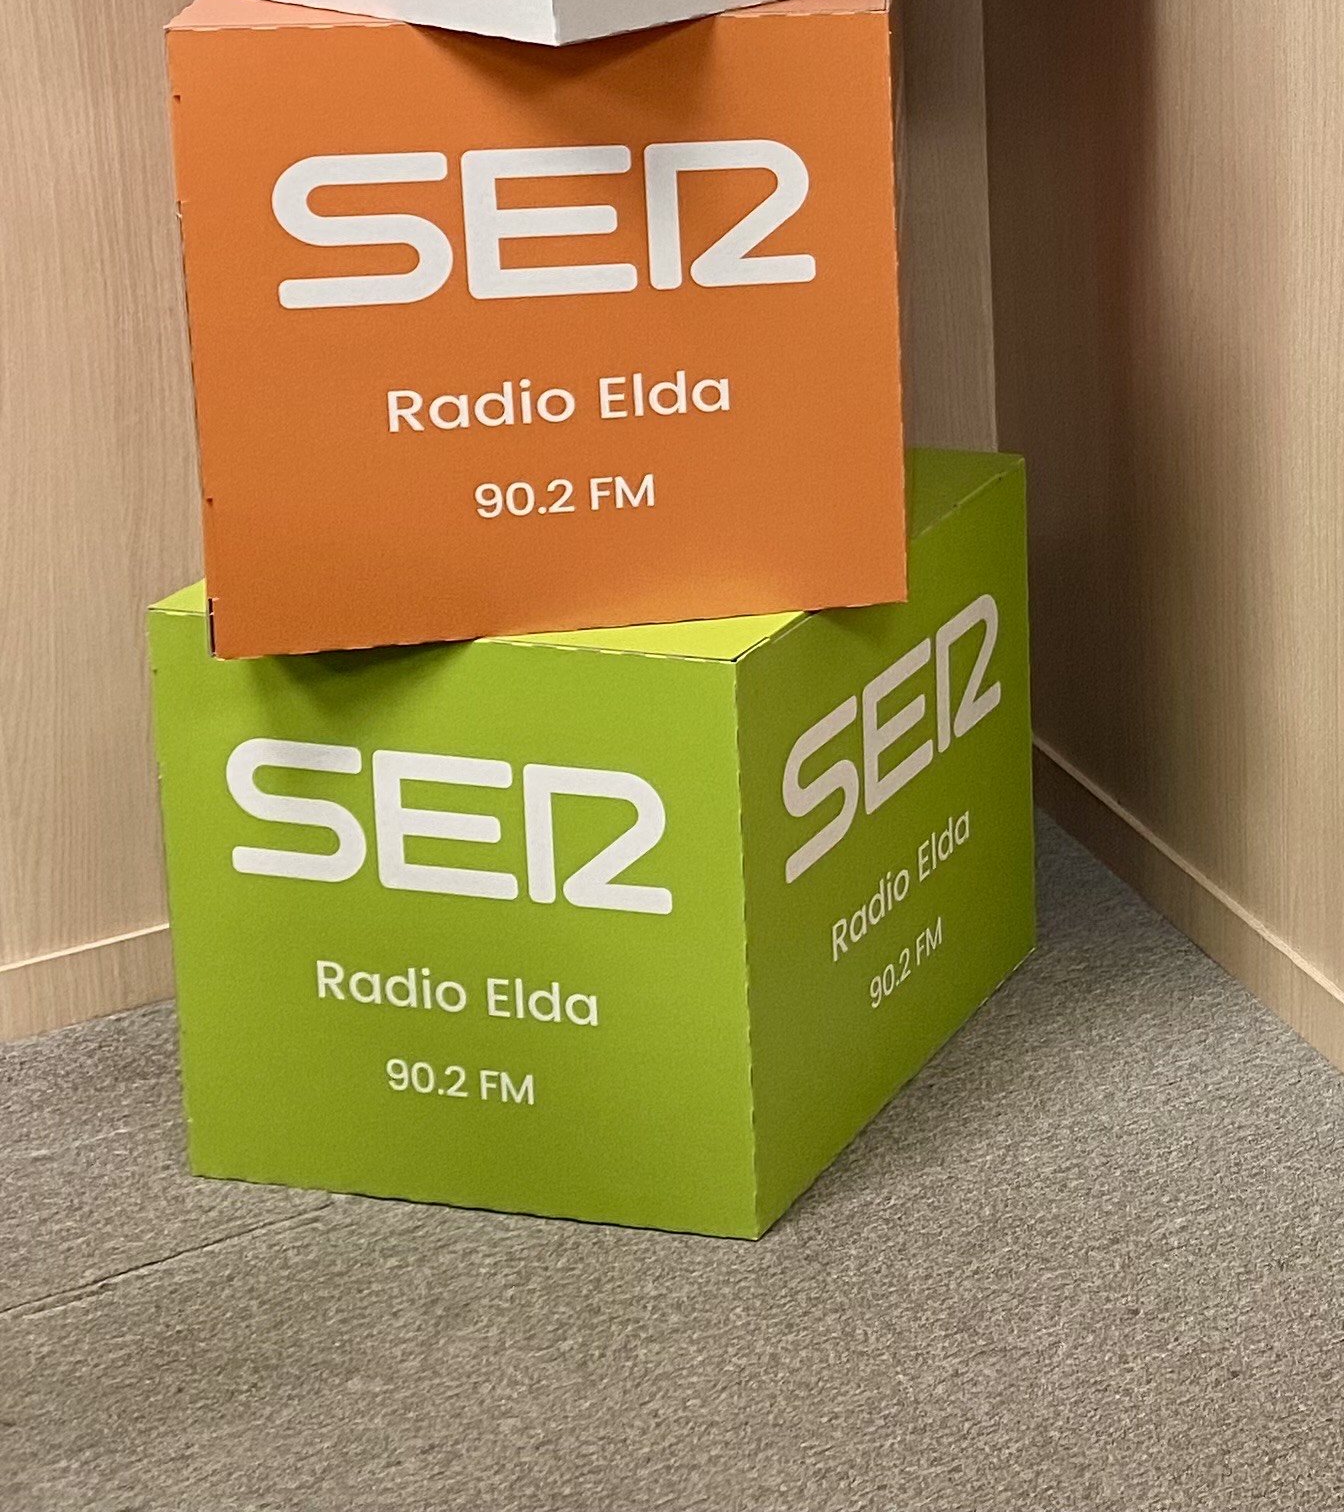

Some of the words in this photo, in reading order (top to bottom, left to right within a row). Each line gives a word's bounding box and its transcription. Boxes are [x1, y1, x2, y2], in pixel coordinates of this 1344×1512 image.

[272, 140, 816, 308] SER
[388, 379, 575, 433] Radio
[600, 371, 729, 419] Elda
[475, 479, 575, 517] 90.2
[591, 474, 654, 510] FM
[783, 593, 1002, 884] SER
[226, 738, 672, 914] SER
[832, 865, 910, 961] Radio
[919, 811, 969, 882] Elda
[317, 960, 466, 1012] Radio
[487, 978, 598, 1026] Elda
[869, 954, 912, 1008] 90.2
[916, 917, 942, 965] FM
[387, 1059, 468, 1097] 90.2
[480, 1070, 534, 1105] FM
